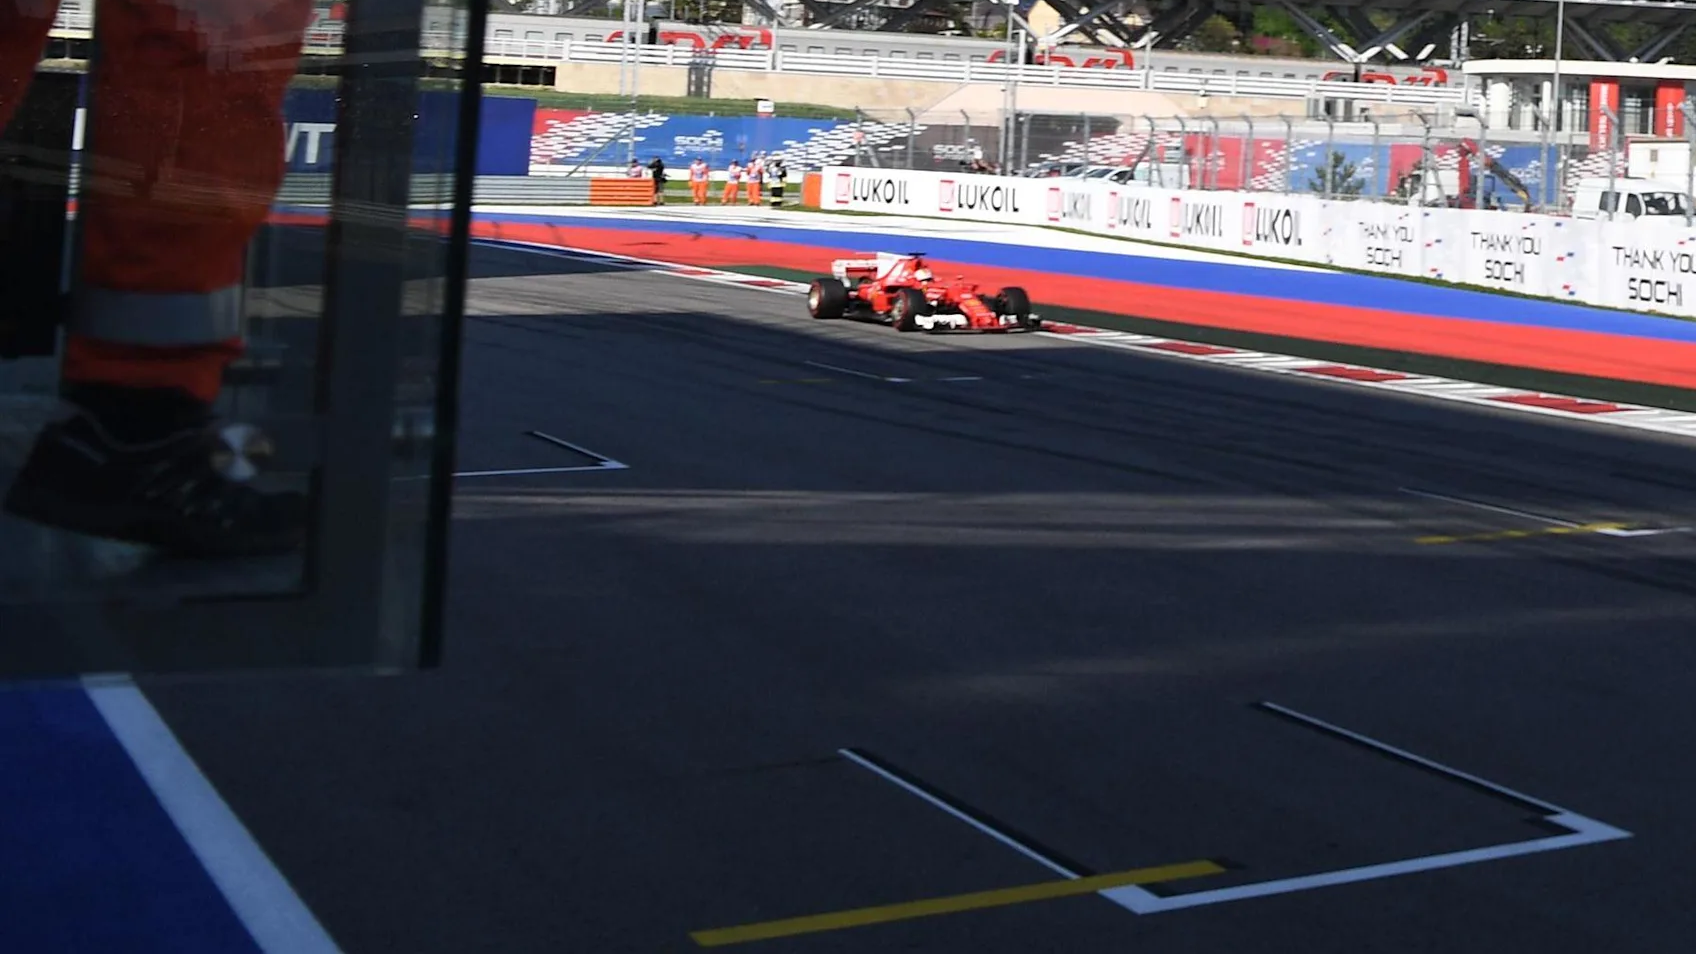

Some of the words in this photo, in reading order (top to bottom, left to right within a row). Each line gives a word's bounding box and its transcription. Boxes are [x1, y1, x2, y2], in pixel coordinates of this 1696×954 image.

[852, 178, 910, 204] LUKOIL
[958, 184, 1019, 212] LUKOIL
[1470, 232, 1514, 252] THANK
[1517, 236, 1541, 256] YOU
[1612, 246, 1665, 271] THANK
[1484, 259, 1525, 284] SOCHI
[1628, 278, 1683, 306] SOCHI
